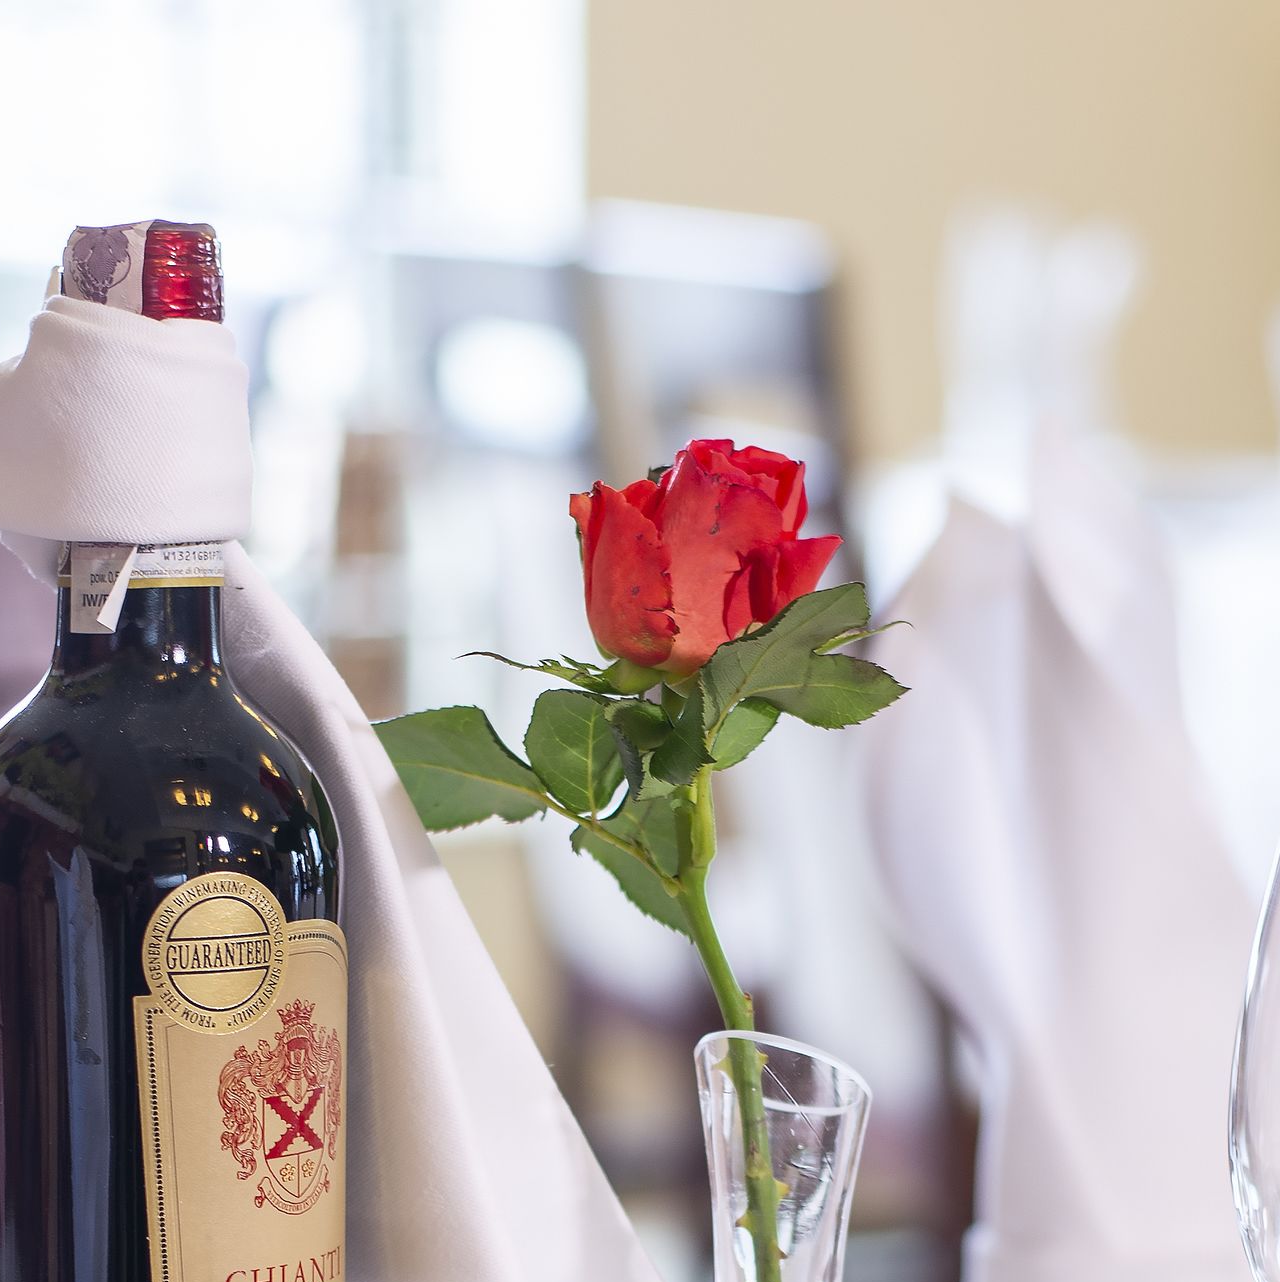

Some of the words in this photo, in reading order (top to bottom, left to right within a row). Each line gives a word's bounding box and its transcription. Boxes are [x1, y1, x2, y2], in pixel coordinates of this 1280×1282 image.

[130, 567, 183, 577] enominazione
[173, 880, 247, 908] WINEMAKING
[248, 887, 283, 947] EXPERIENCE
[147, 905, 177, 980] GENERATION
[166, 939, 272, 970] GUARANTEED
[274, 949, 284, 965] OF
[262, 967, 282, 999] SENSI
[160, 989, 181, 1013] THE
